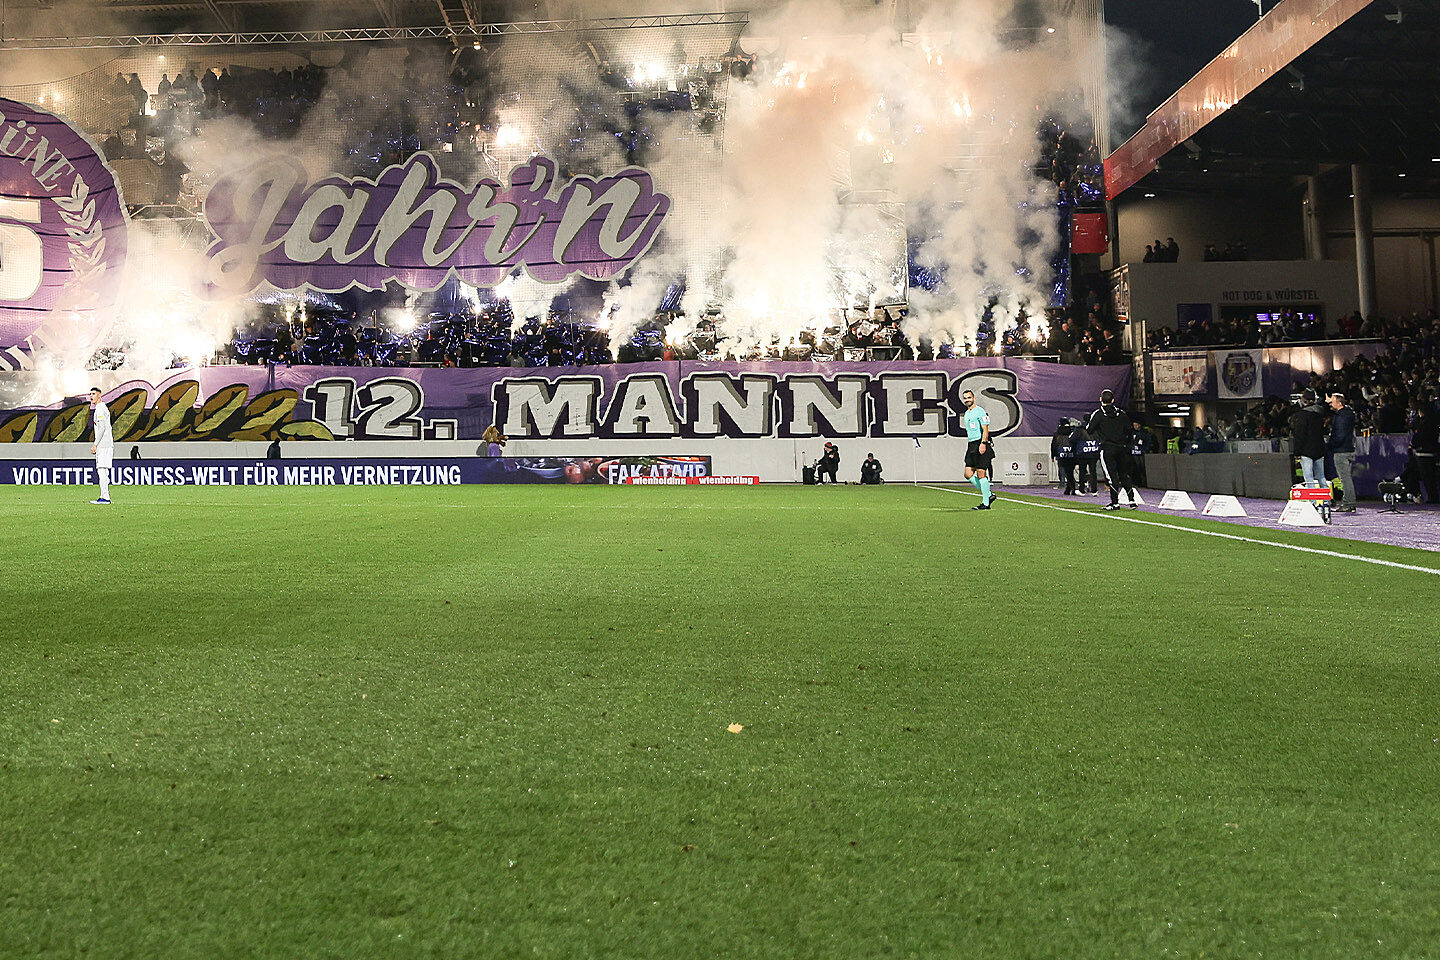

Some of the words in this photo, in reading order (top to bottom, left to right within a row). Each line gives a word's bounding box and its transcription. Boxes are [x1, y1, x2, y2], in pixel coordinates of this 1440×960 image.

[1222, 290, 1241, 301] HOT
[1243, 290, 1262, 300] DOG
[1274, 287, 1320, 301] WÜRSTEL
[309, 378, 453, 440] 12.
[501, 370, 1018, 440] MANNES
[12, 466, 95, 486] VIOLETTE
[243, 462, 280, 486] FÜR
[283, 466, 337, 486] MEHR
[340, 465, 461, 486] VERNETZUNG
[698, 476, 755, 486] wienholding
